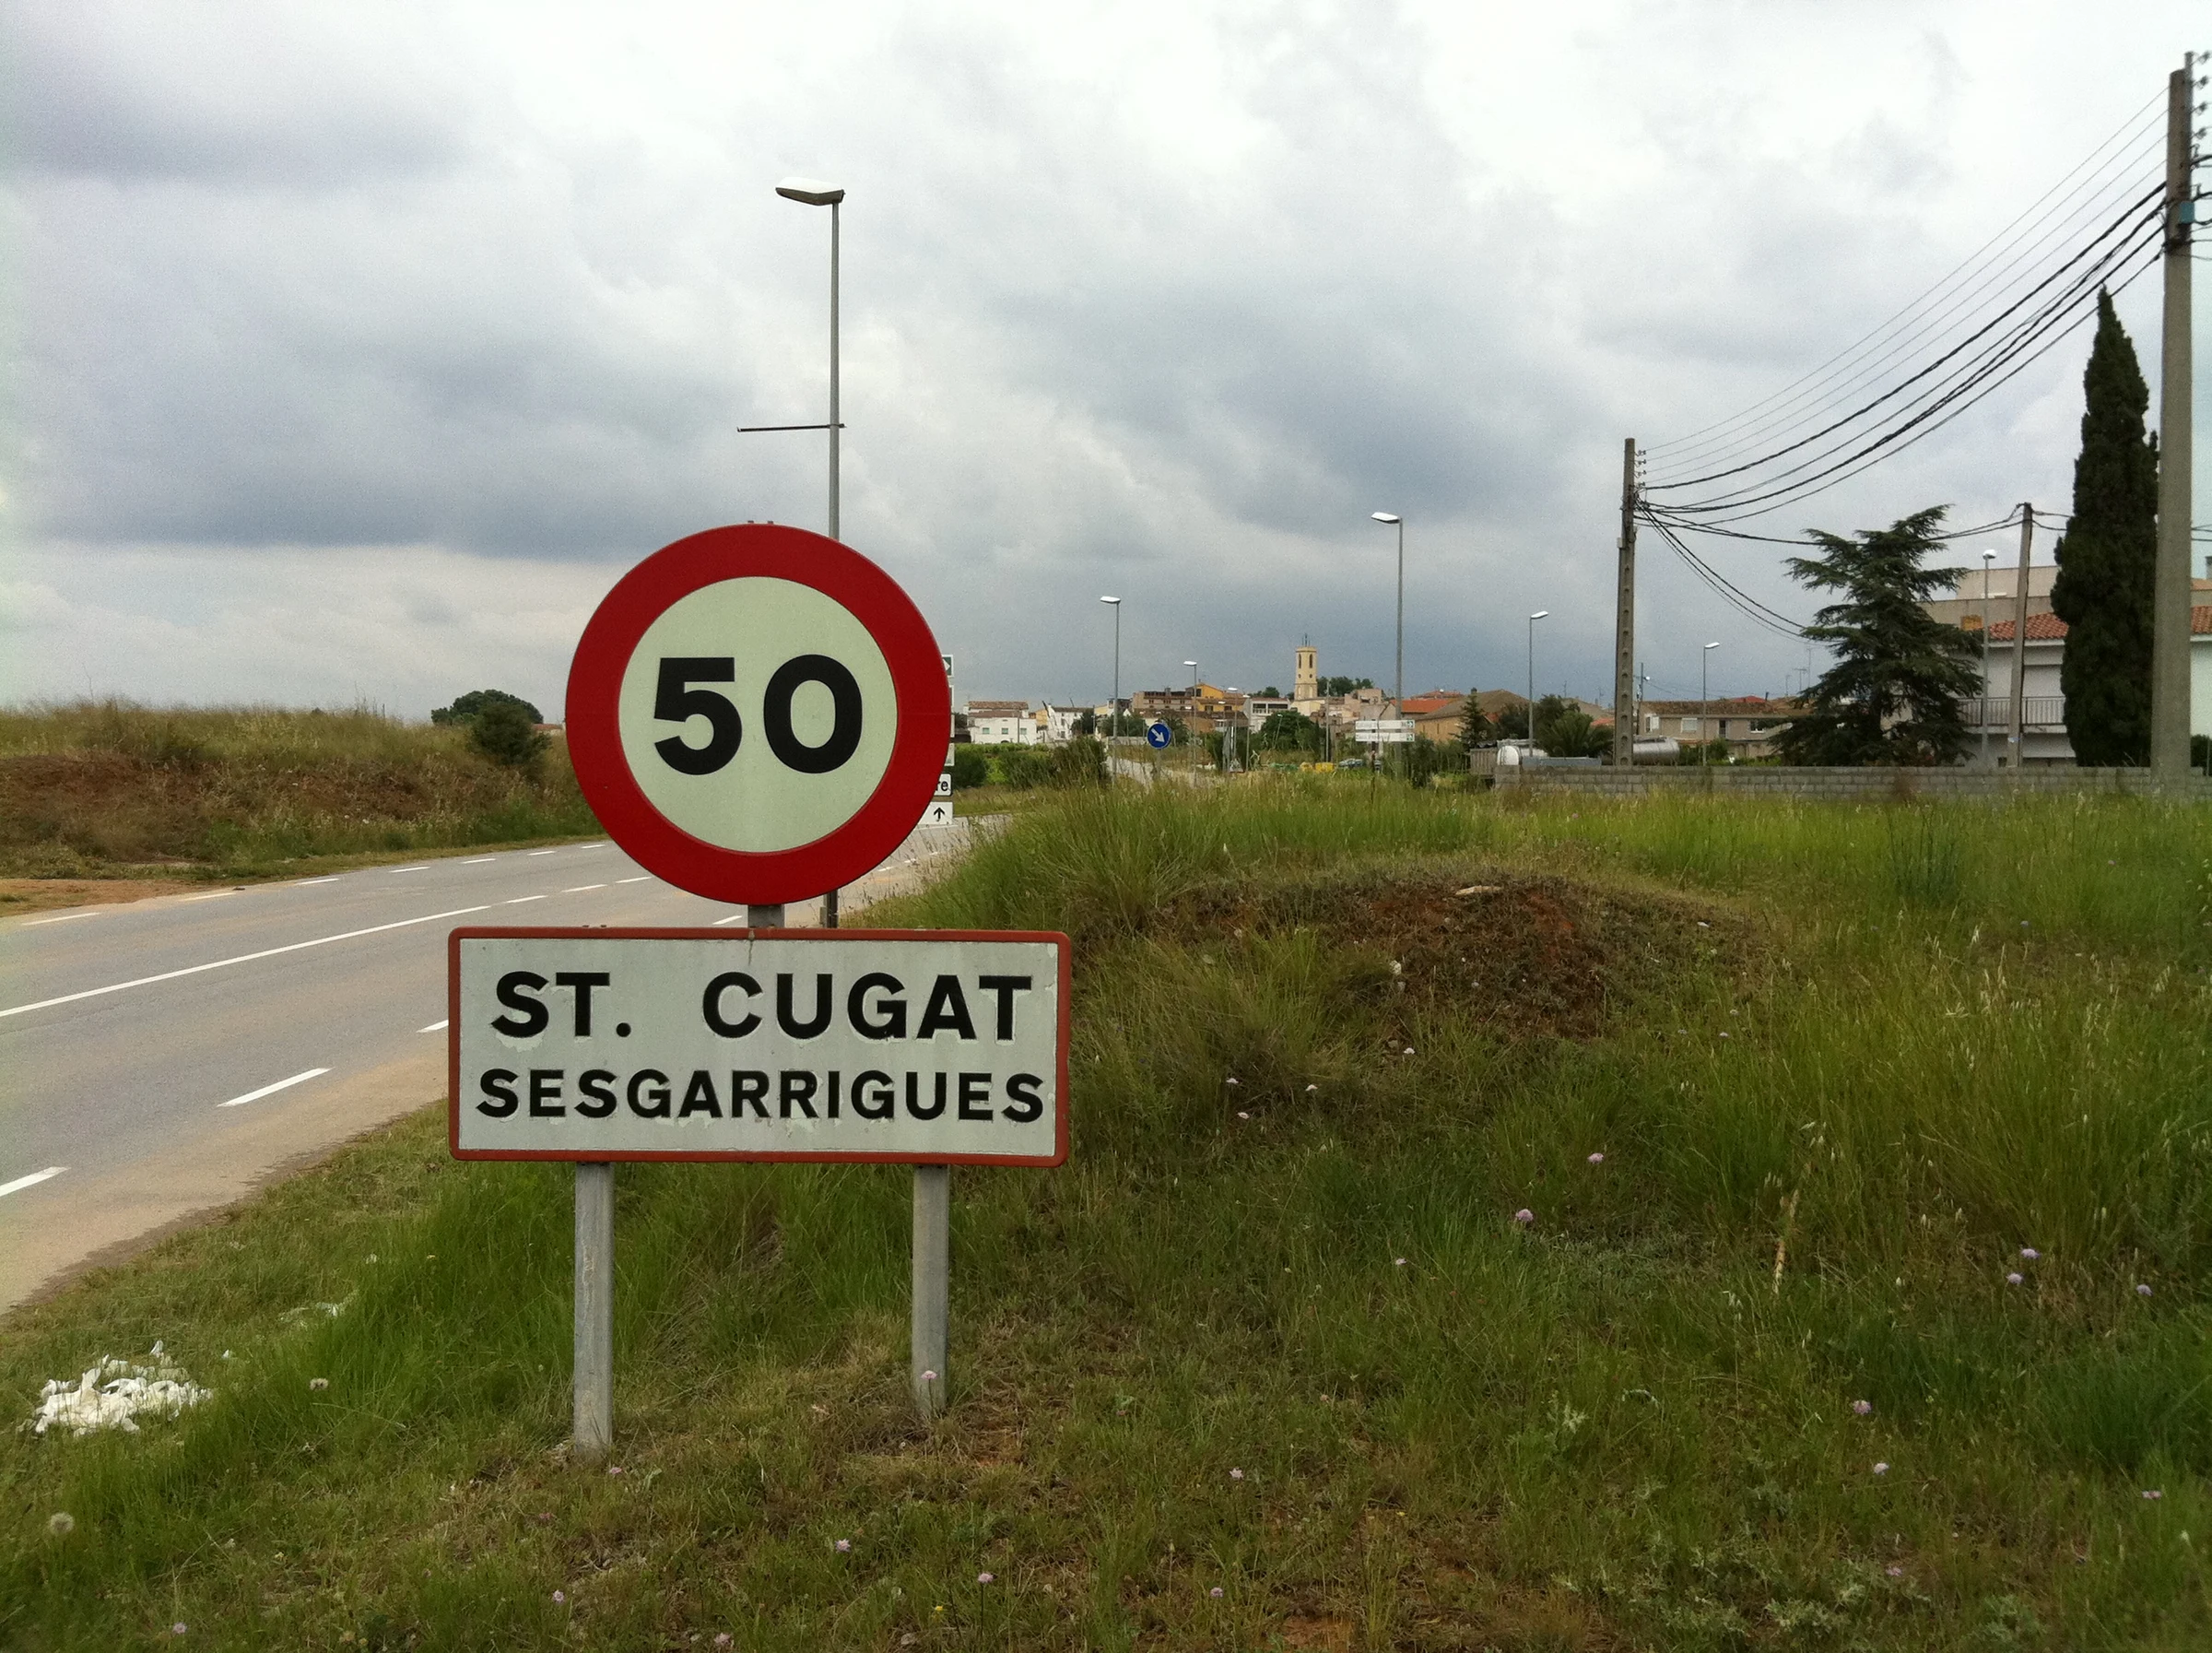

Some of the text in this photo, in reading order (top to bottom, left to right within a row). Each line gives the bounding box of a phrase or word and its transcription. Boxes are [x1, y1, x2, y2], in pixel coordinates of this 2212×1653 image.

[653, 654, 863, 775] 50
[490, 971, 1032, 1042] ST. CUGAT
[476, 1068, 1044, 1123] SESGARRIGUES
